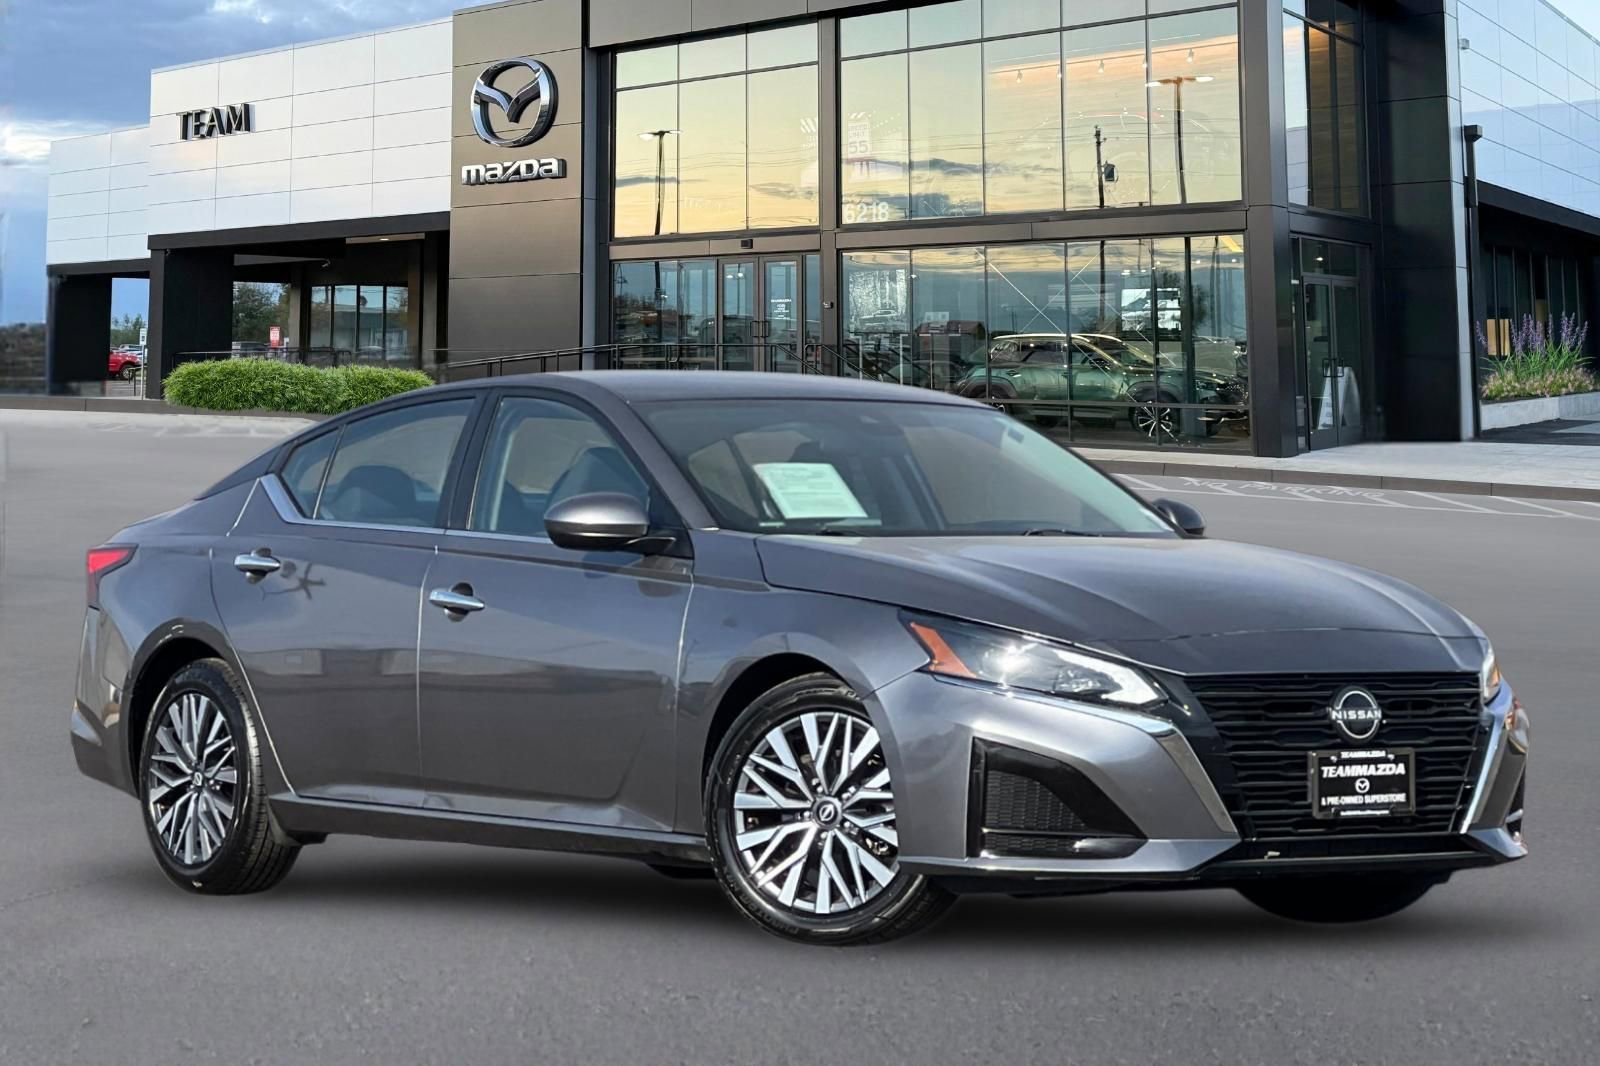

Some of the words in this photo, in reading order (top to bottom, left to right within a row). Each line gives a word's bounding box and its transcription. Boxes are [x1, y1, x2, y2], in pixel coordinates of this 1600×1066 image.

[176, 103, 250, 140] TEAM
[848, 140, 868, 154] 55
[461, 158, 565, 185] mazda
[845, 202, 889, 223] 6218
[1239, 482, 1385, 498] PARKING
[1331, 709, 1382, 720] NISSAN
